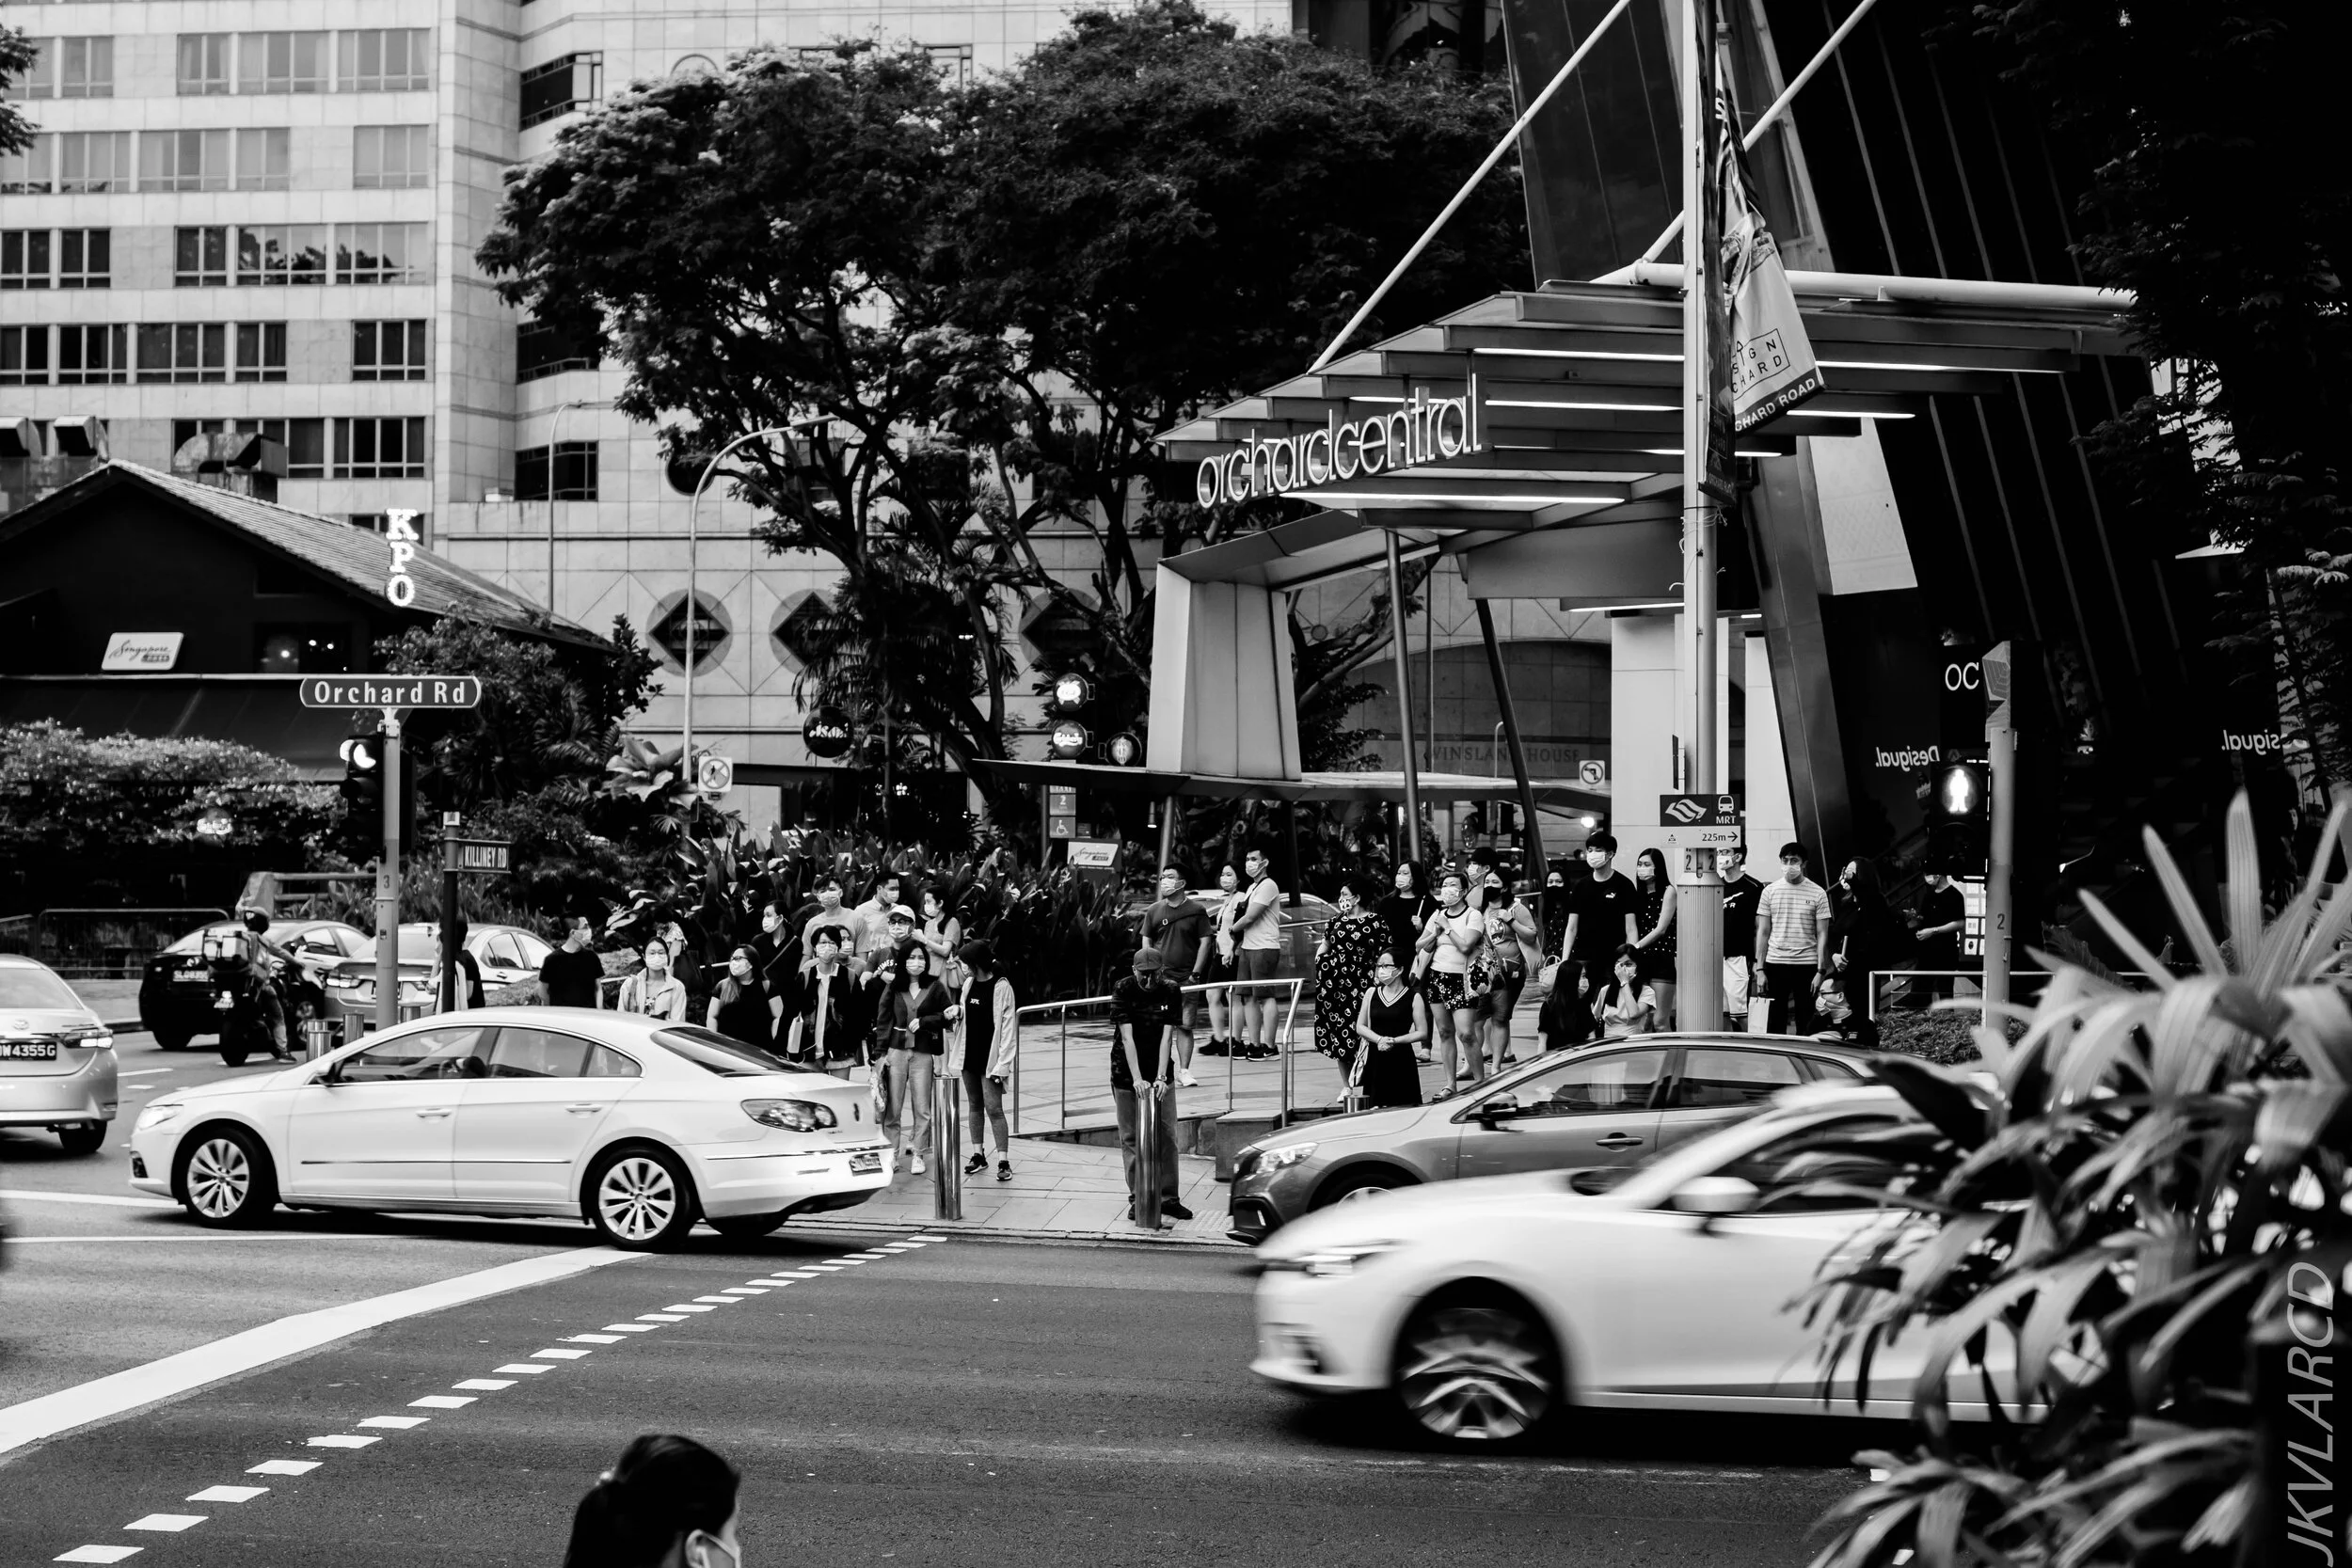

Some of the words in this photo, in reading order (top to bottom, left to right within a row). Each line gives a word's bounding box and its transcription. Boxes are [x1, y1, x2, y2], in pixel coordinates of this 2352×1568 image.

[1779, 378, 1816, 407] ROAD
[385, 508, 420, 607] KPO
[1945, 661, 1979, 691] OC
[314, 681, 423, 704] Orchard
[434, 681, 465, 704] Rd
[1527, 748, 1580, 764] HOUSE
[1059, 794, 1067, 805] 2
[1715, 816, 1736, 825] MRT
[1702, 832, 1726, 842] 225m
[464, 845, 497, 868] KILLINEY
[497, 847, 508, 868] RD
[383, 874, 390, 890] 3
[1996, 912, 2006, 930] 2
[0, 1044, 56, 1057] W4355G
